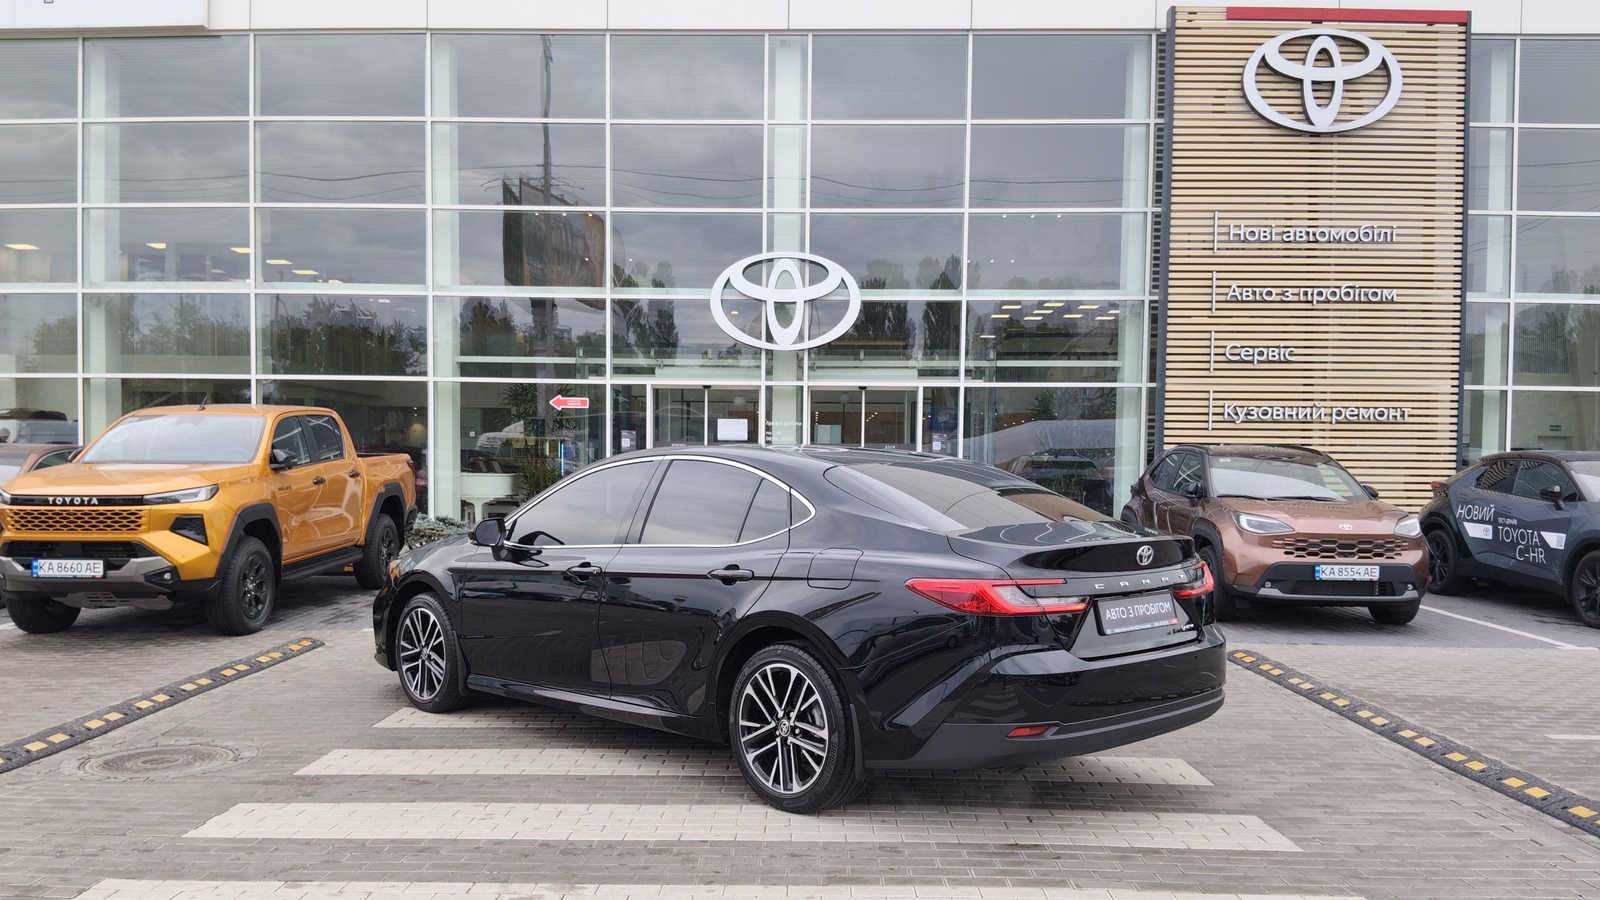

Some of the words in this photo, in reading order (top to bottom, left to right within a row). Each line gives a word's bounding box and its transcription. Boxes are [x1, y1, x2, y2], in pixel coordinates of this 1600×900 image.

[1229, 224, 1276, 242] Нові
[1282, 224, 1397, 242] автомобілі
[1226, 284, 1276, 301] Авто
[1281, 287, 1293, 301] з
[1299, 284, 1397, 306] пробігом
[1225, 344, 1296, 365] Сервіс
[1223, 402, 1325, 424] Кузовний
[1331, 406, 1412, 424] ремонт
[48, 497, 99, 505] TOYOTA
[1456, 504, 1495, 522] НОВИЙ
[1498, 526, 1540, 546] TOYOTA
[1516, 545, 1546, 564] C-HR
[39, 562, 55, 573] KA
[57, 562, 83, 573] 8660
[85, 563, 101, 573] AE
[1321, 567, 1335, 576] KA
[1338, 567, 1361, 577] 8554
[1364, 567, 1377, 577] AE
[1094, 574, 1184, 590] CAMRY
[1106, 607, 1127, 620] АВТО
[1128, 606, 1134, 617] З
[1134, 601, 1171, 616] ПРОБІГОМ
